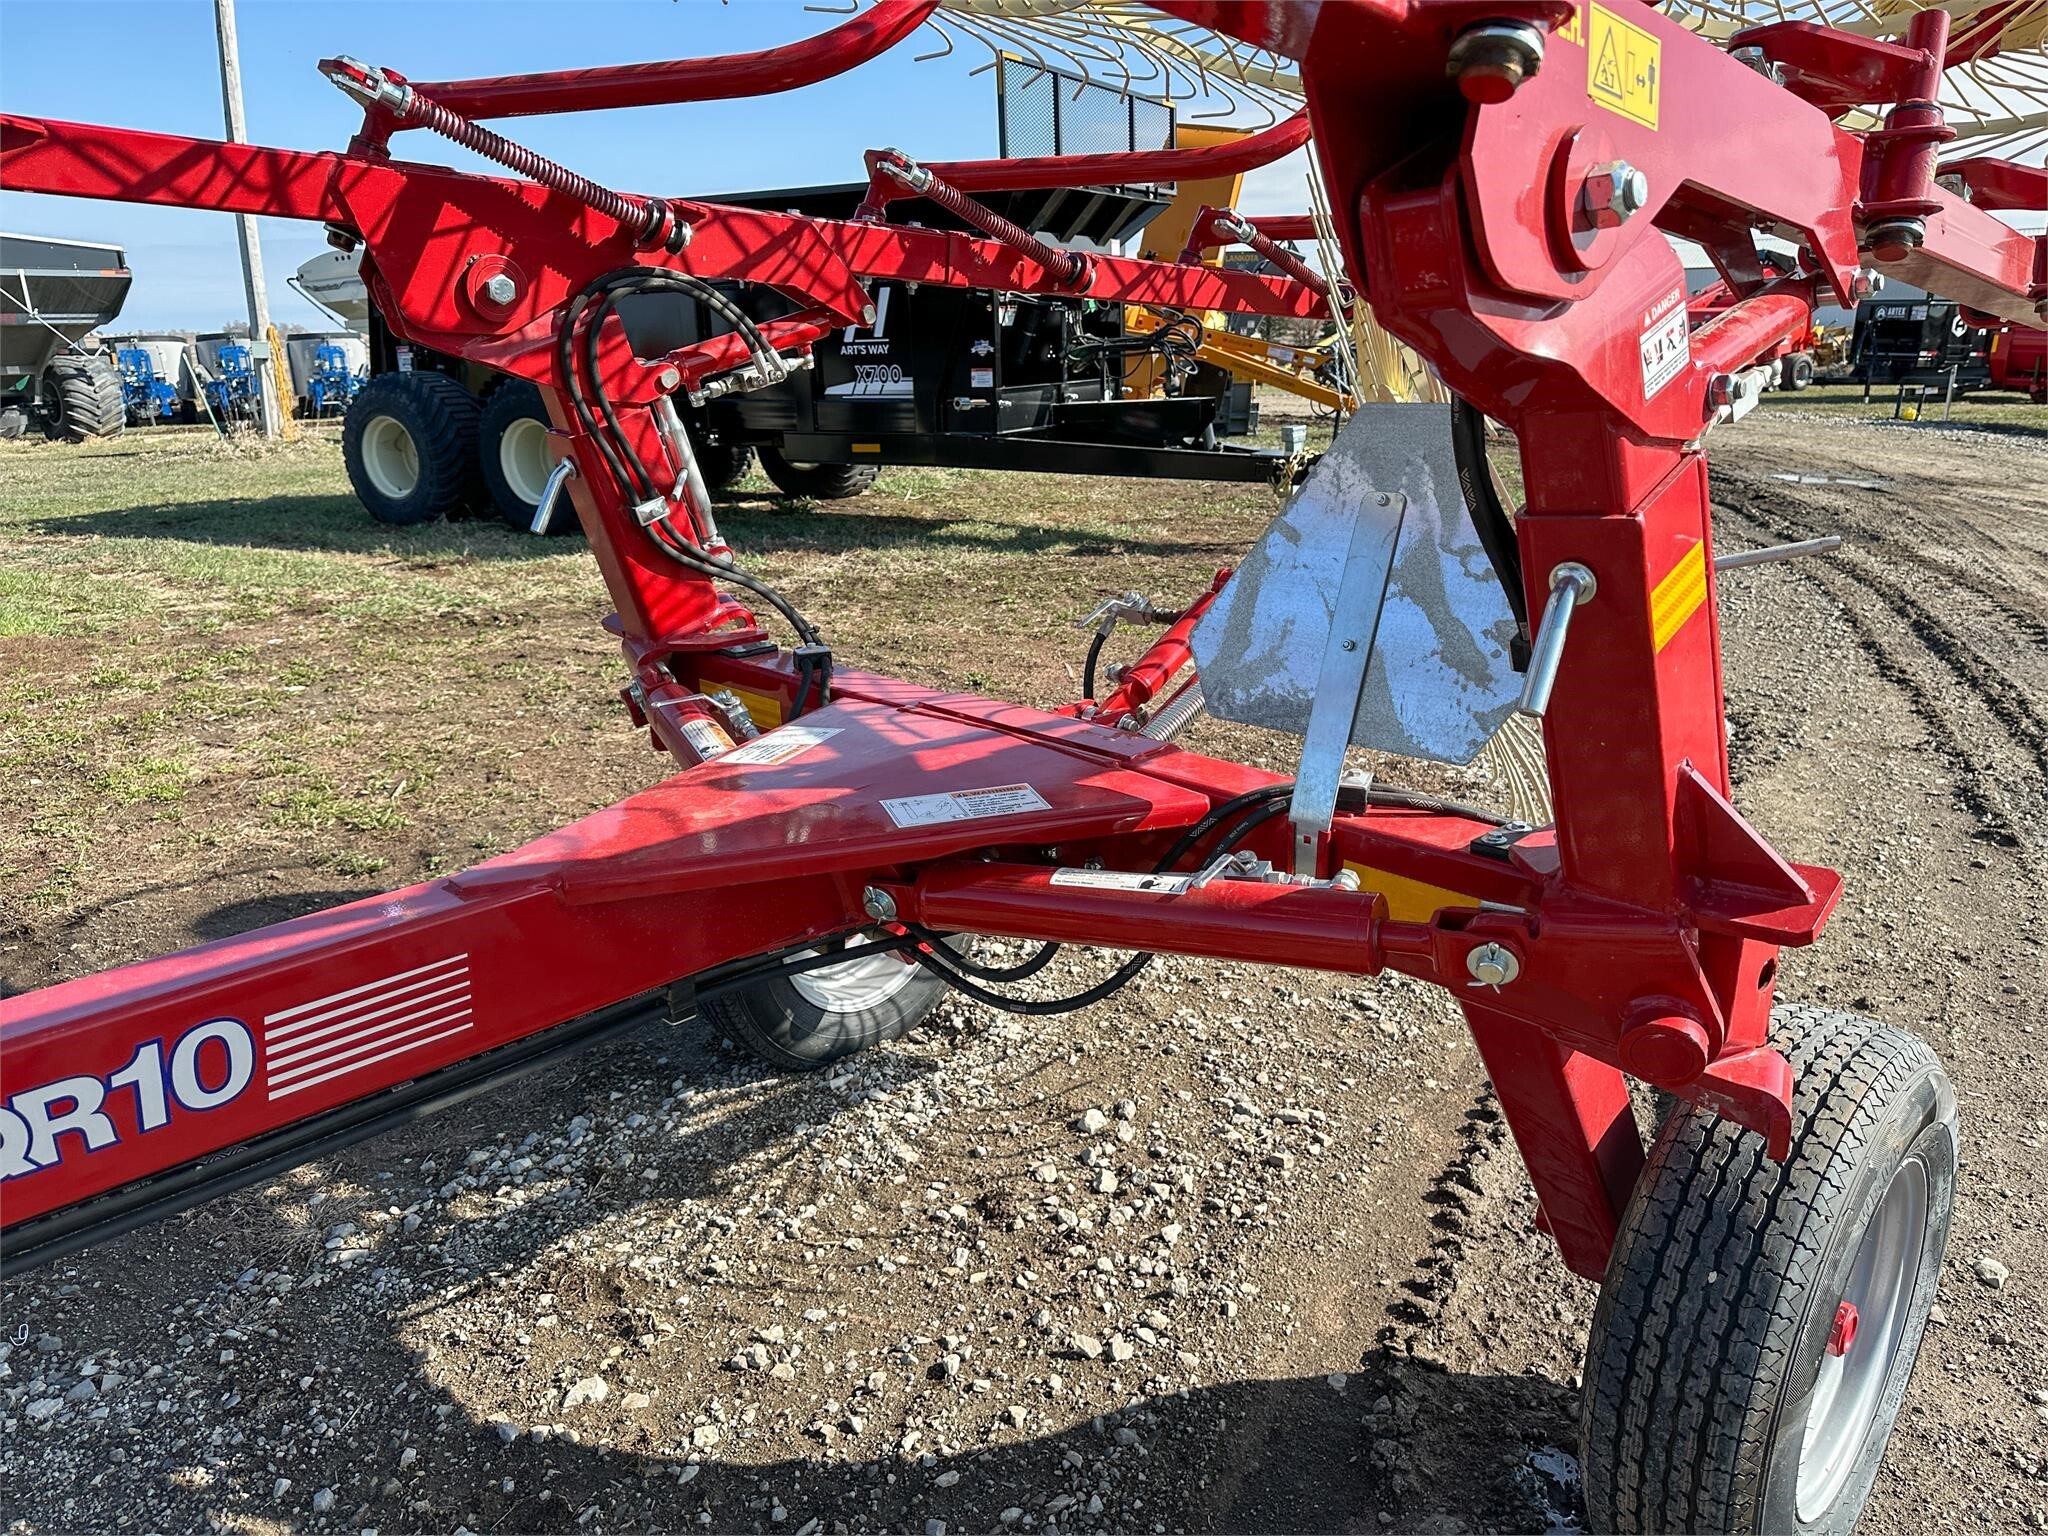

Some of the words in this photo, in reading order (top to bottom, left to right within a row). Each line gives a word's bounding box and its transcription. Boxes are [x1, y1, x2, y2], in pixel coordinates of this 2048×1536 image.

[1651, 288, 1681, 320] DANGER
[840, 345, 867, 355] ART'S
[867, 344, 890, 354] WAY
[854, 364, 903, 384] X700
[972, 785, 1022, 796] WARNING
